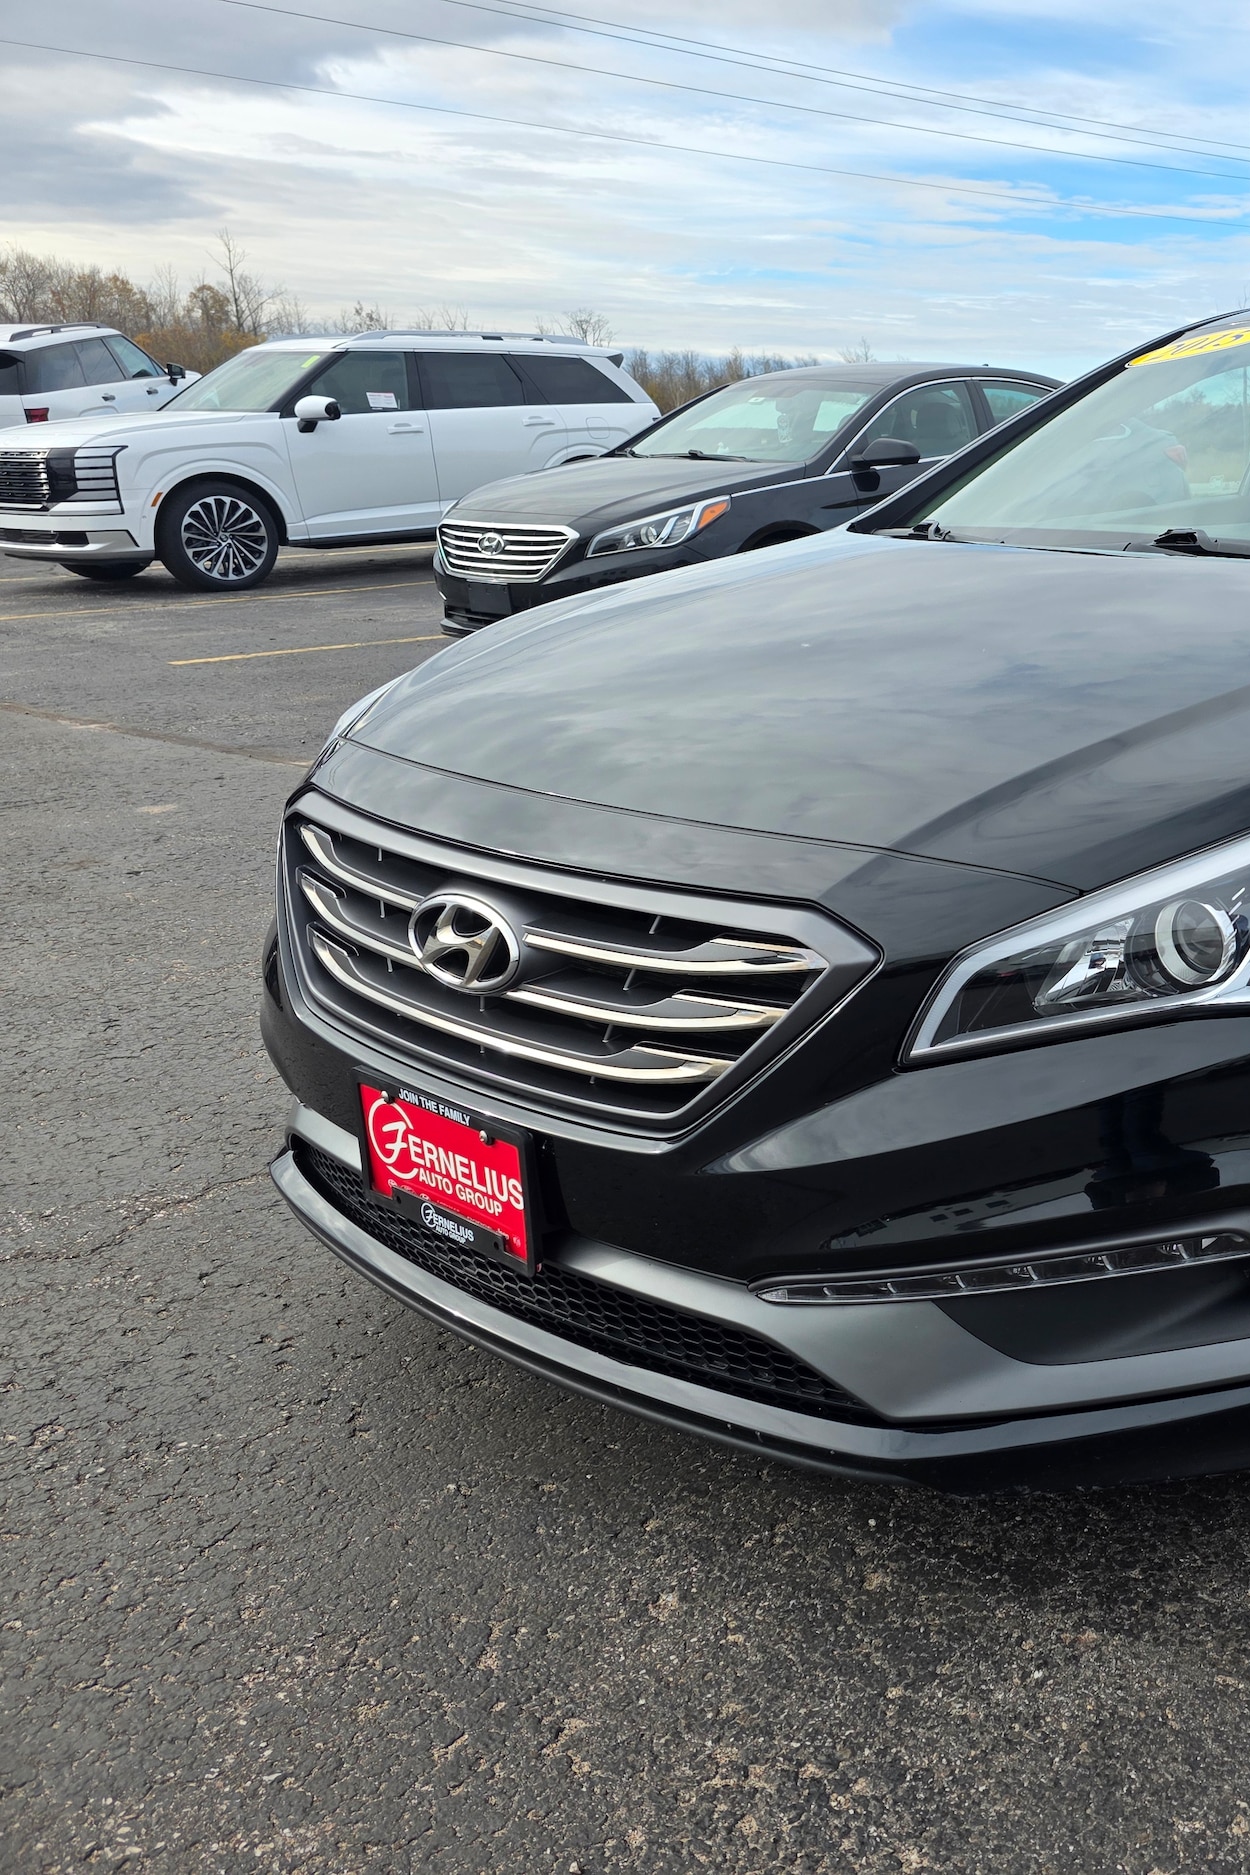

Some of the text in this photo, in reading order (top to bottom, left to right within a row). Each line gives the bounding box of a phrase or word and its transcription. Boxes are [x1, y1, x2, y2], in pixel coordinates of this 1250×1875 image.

[398, 1088, 471, 1127] JOIN THE FAMILY
[368, 1098, 525, 1210] FERNELIUS
[418, 1167, 503, 1217] AUTO GROUP
[420, 1202, 474, 1242] FERNELIUS
[435, 1225, 467, 1244] AUTO GROUP
